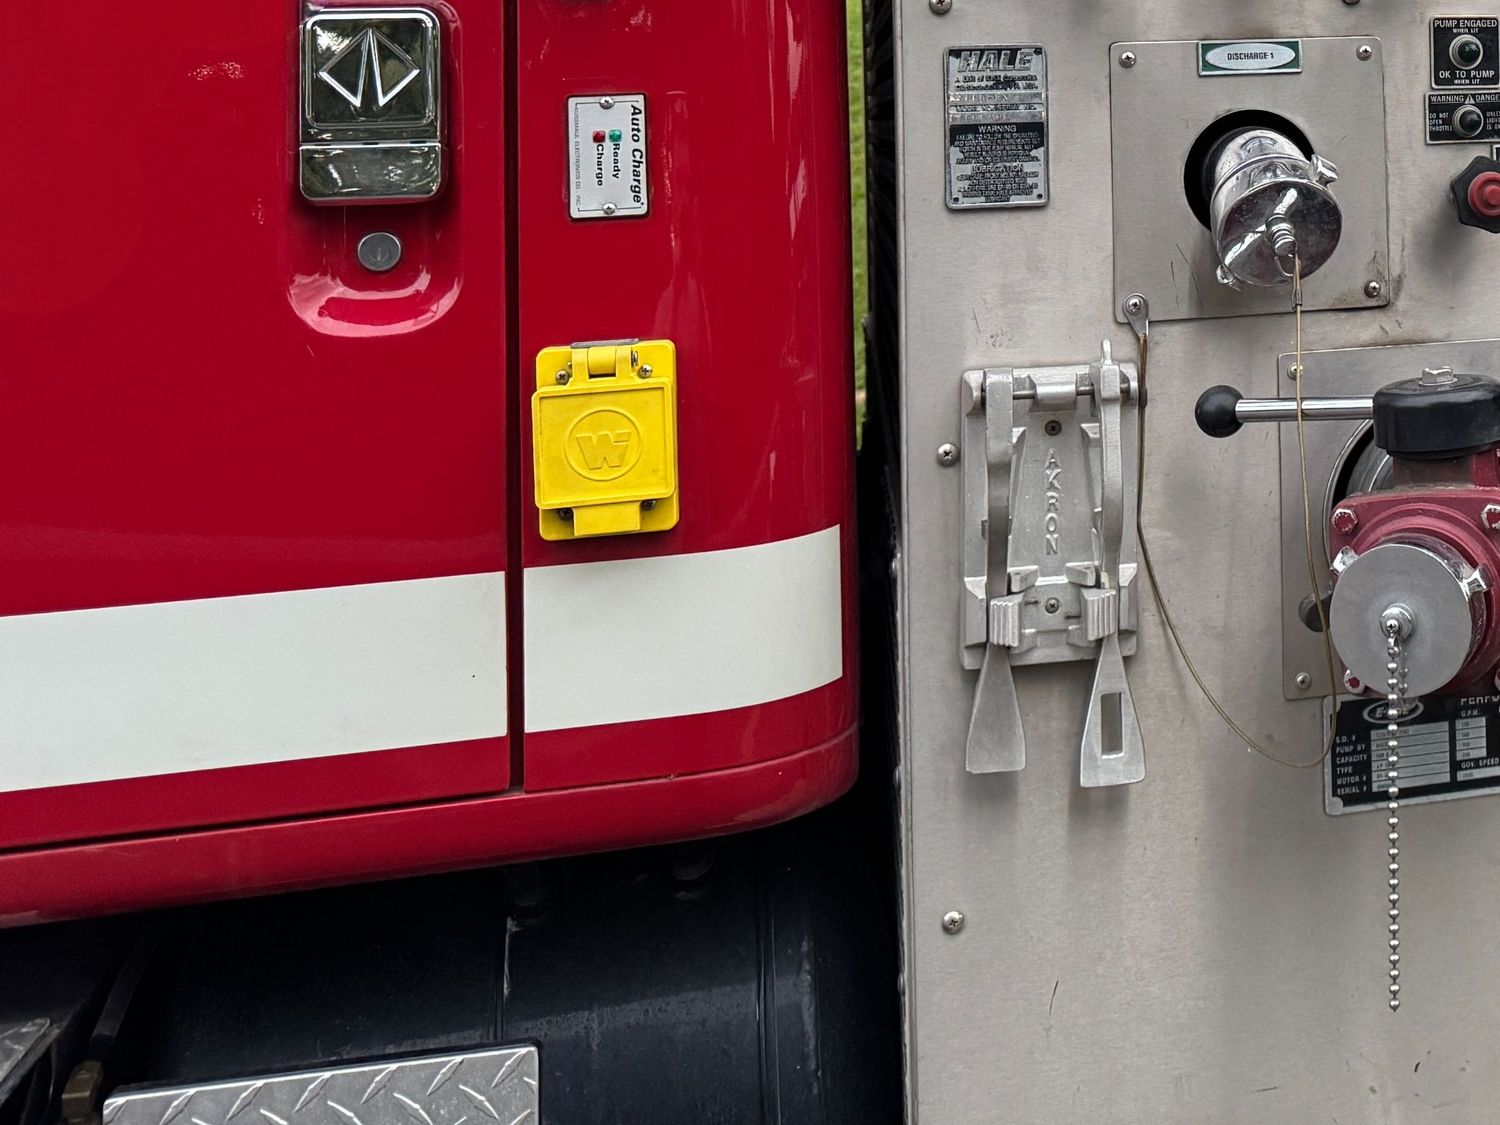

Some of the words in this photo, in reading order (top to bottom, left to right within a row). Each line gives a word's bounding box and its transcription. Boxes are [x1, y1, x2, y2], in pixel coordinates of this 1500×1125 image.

[1434, 19, 1458, 28] PUMP
[1460, 19, 1498, 27] ENGAGED
[1227, 52, 1268, 61] DISCHARGE
[958, 50, 1035, 73] HALE
[1439, 71, 1450, 79] OK
[1470, 69, 1495, 78] PUMP
[1430, 95, 1464, 103] WARNING
[630, 105, 642, 143] Auto
[978, 125, 1016, 133] WARNING
[596, 143, 604, 187] Charge
[612, 143, 621, 179] Ready
[630, 147, 644, 203] Charge
[1045, 447, 1062, 555] AKRON
[1336, 745, 1353, 753] PUMP
[1336, 755, 1367, 763] CAPACITY
[1462, 761, 1476, 769] GOV.
[1478, 757, 1500, 766] SPEED
[1336, 766, 1352, 775] TYPE
[1337, 776, 1360, 785] MOTOR
[1337, 787, 1360, 795] SERIAL
